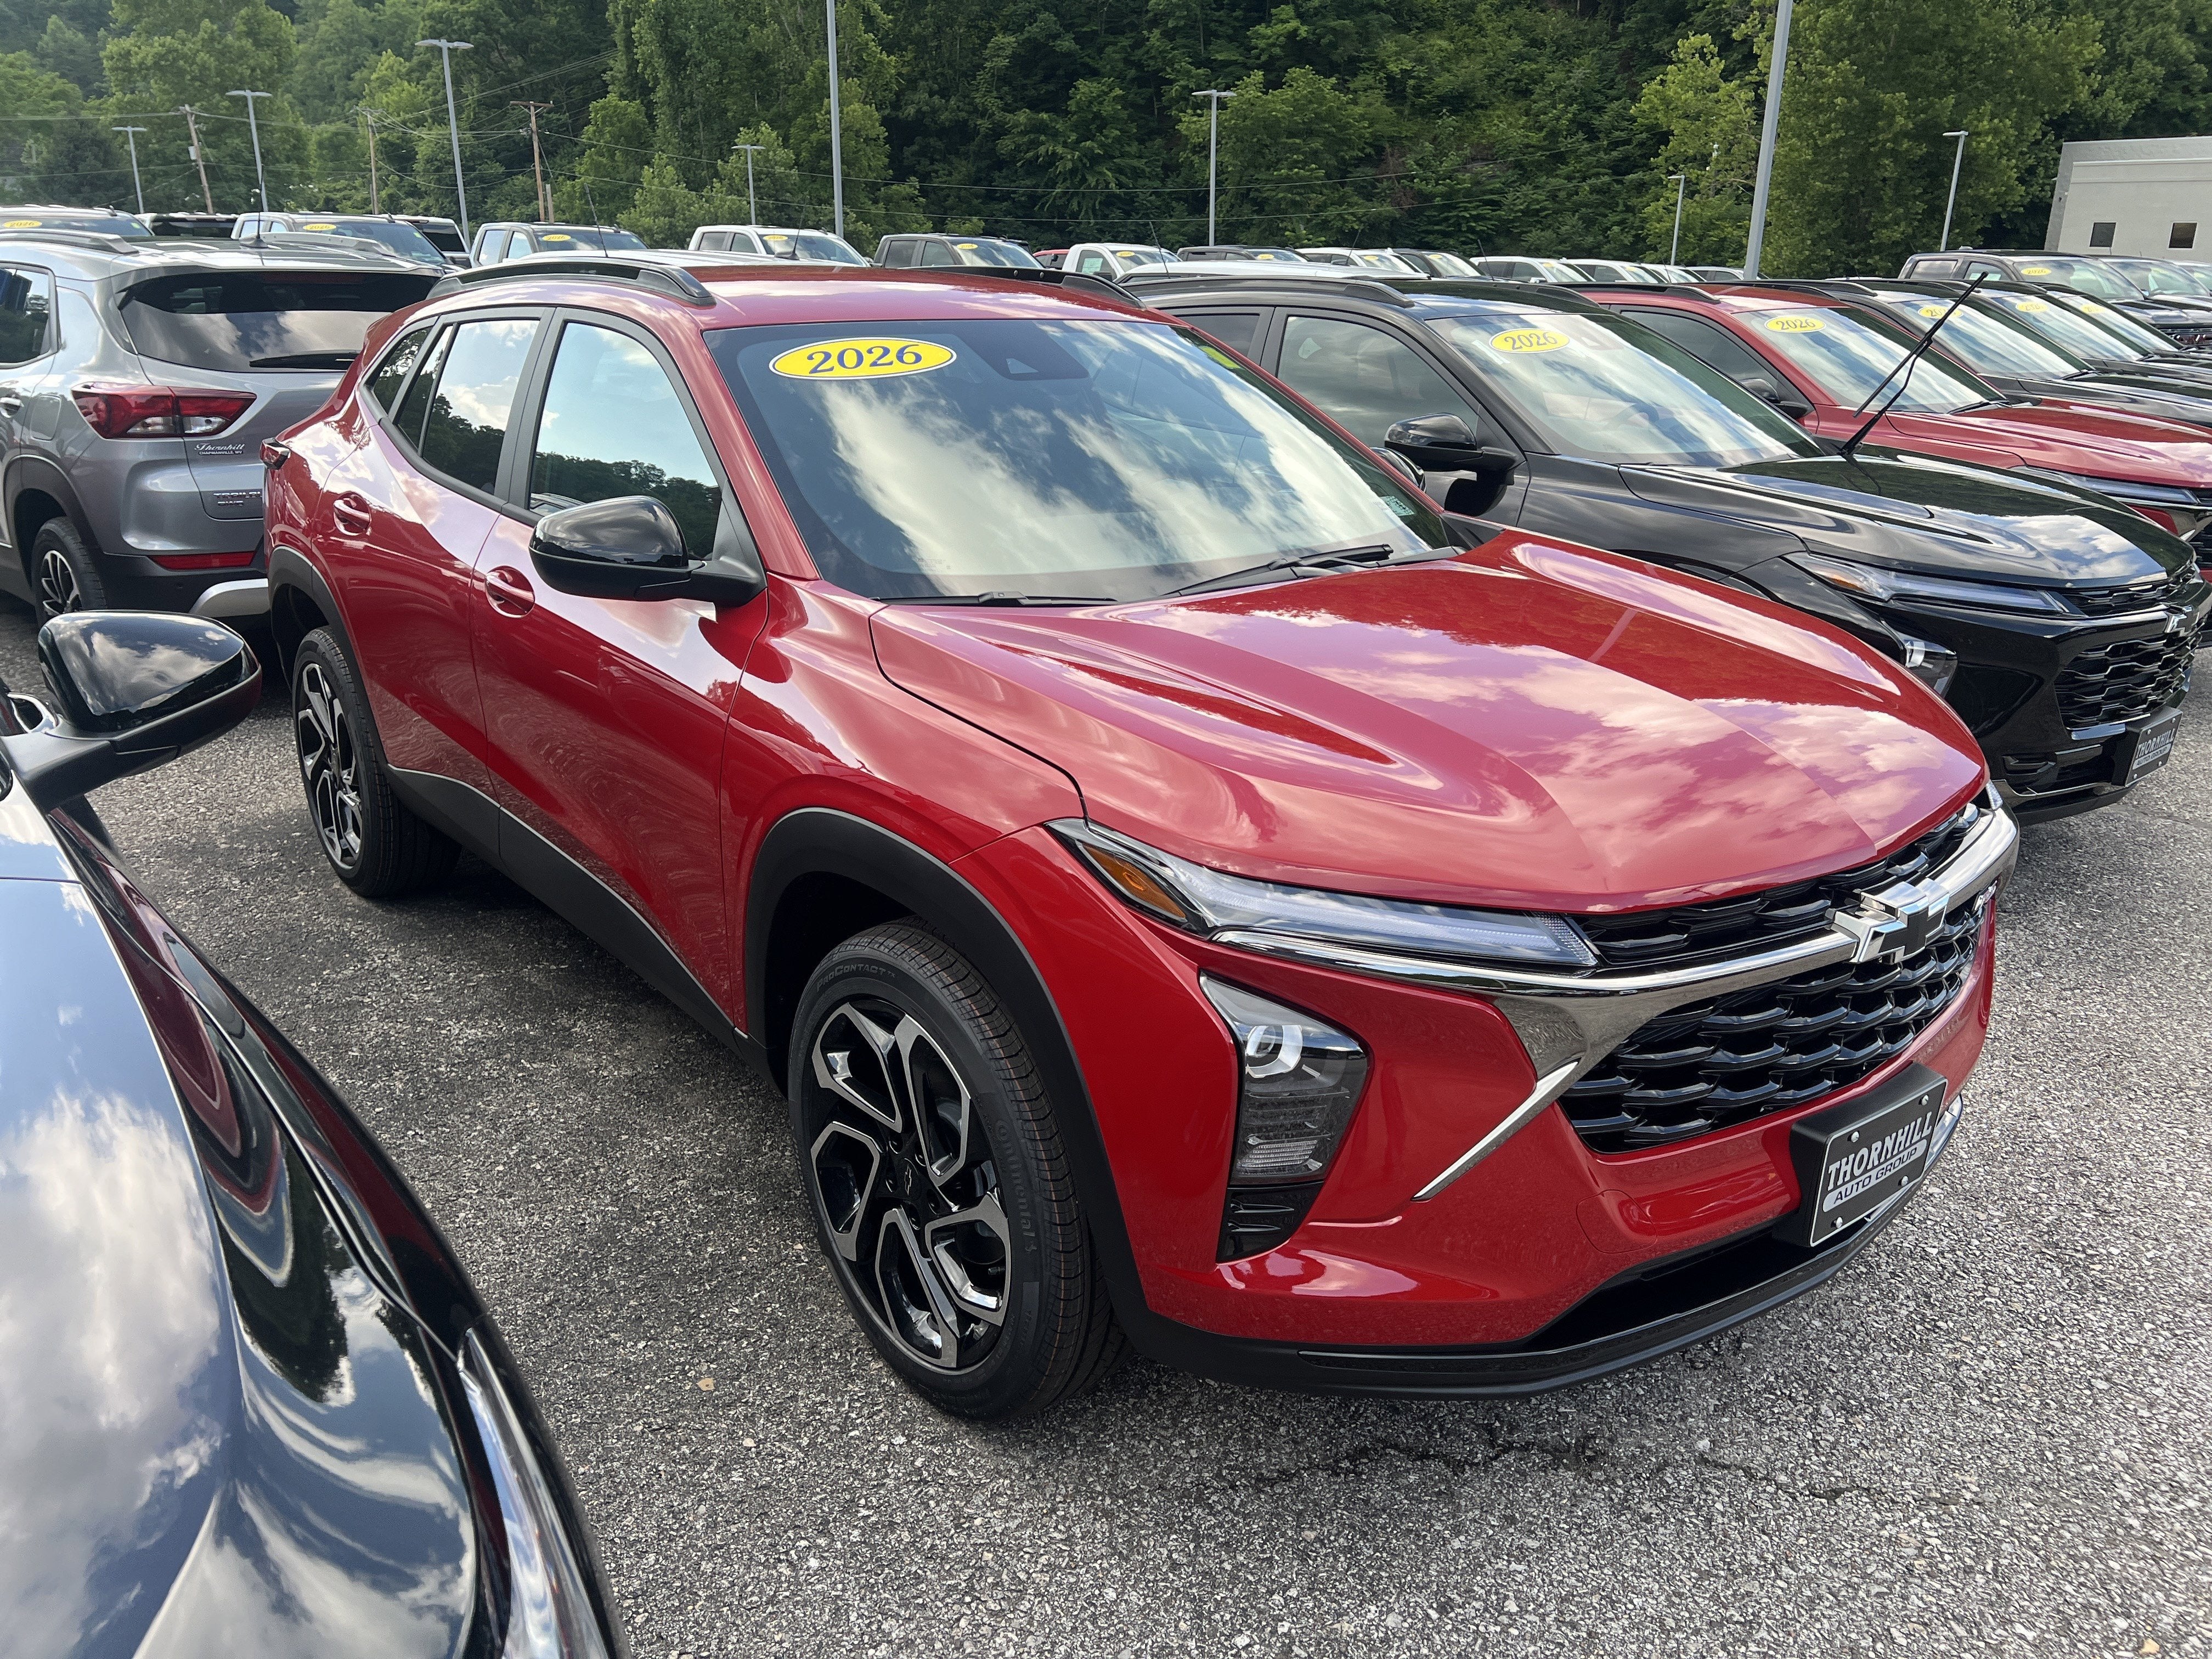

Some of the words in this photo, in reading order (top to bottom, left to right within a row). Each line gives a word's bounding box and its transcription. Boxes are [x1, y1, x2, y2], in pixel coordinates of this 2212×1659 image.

[1776, 319, 1816, 330] 2026
[1504, 332, 1558, 351] 2026
[806, 344, 923, 374] 2026
[194, 443, 245, 451] Thornhill
[2135, 727, 2176, 759] THORNHILL
[1827, 1111, 1933, 1192] THORNHILL
[1833, 1176, 1871, 1205] AUTO
[1875, 1147, 1918, 1180] GROUP
